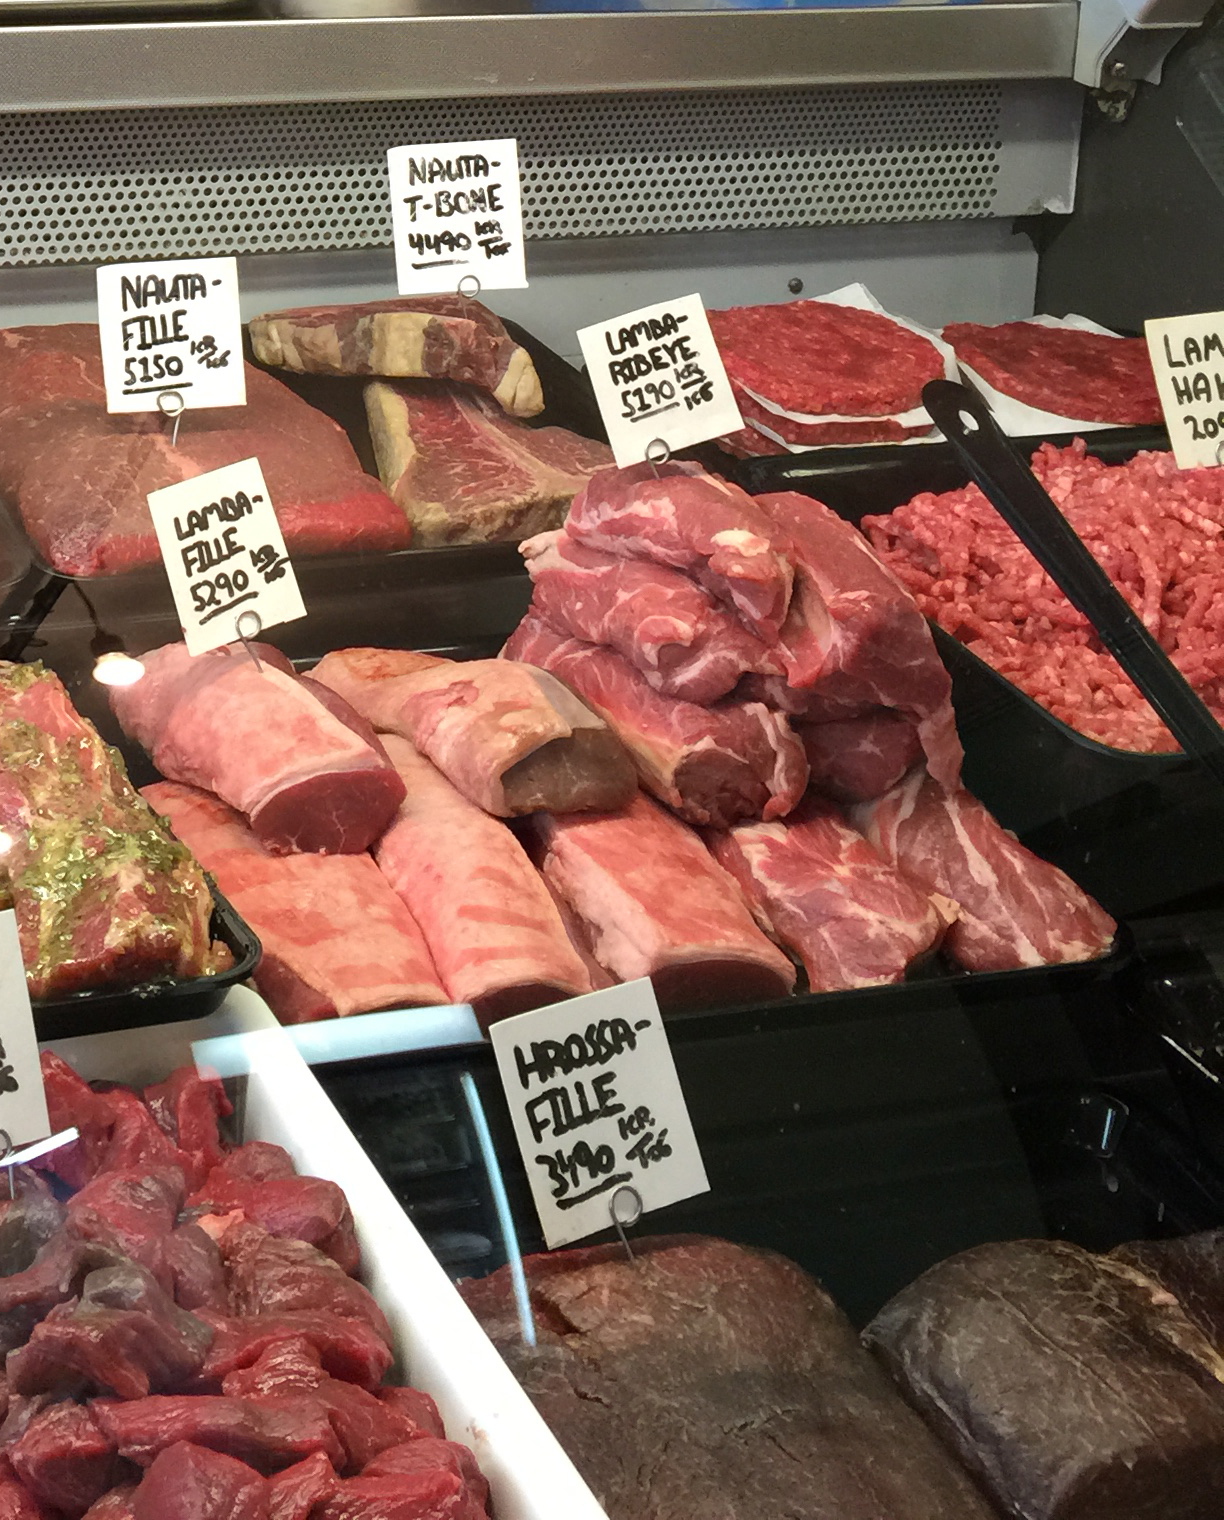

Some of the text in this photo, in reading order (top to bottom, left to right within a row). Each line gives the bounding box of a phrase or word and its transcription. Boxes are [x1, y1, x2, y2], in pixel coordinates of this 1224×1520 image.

[408, 154, 501, 186] NAUTA-
[403, 183, 504, 222] T-BONE
[408, 230, 472, 256] 4490
[121, 273, 222, 312] NAUTA-
[122, 309, 189, 351] FILLE
[605, 313, 689, 356] LAMBA-
[124, 353, 184, 386] 5150
[608, 335, 700, 386] RIBEYE
[621, 379, 676, 418] 5190
[174, 491, 263, 541] LAMBA-
[181, 526, 246, 578] FILLE
[190, 569, 249, 612] 5290
[513, 1018, 651, 1090] HROSSA-
[525, 1071, 626, 1144] FILLE
[535, 1140, 616, 1198] 3490
